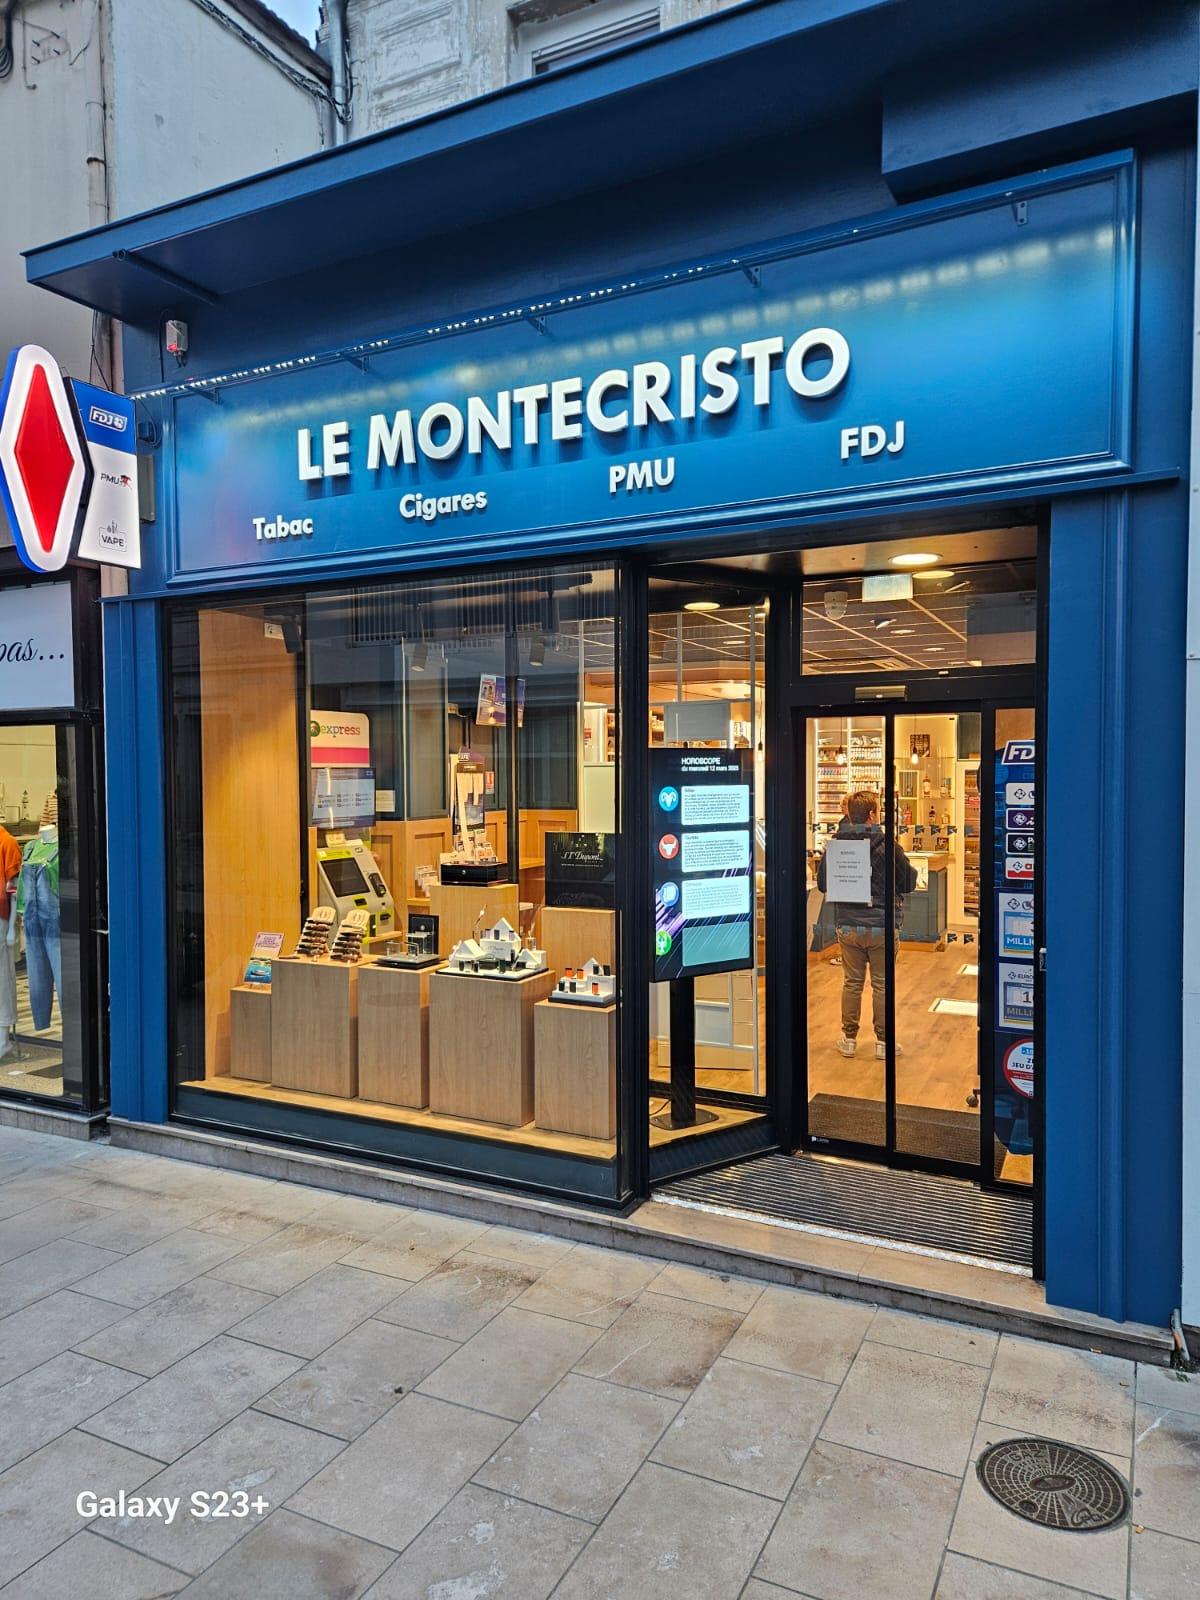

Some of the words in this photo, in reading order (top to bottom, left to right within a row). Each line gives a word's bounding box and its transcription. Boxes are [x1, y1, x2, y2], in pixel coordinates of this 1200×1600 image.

[297, 421, 349, 481] LE
[366, 327, 850, 471] MONTECRISTO
[92, 410, 114, 426] FDJ
[840, 420, 905, 459] FDJ
[100, 473, 119, 486] PMU
[609, 457, 675, 493] PMU
[399, 490, 488, 522] Cigares
[252, 515, 314, 541] Tabac
[101, 534, 125, 547] VAPE
[320, 725, 361, 738] express
[681, 757, 721, 765] HOROSCOPE
[1006, 936, 1034, 946] MILLI
[1006, 1006, 1034, 1017] MILLI
[1009, 1449, 1044, 1461] GAZ
